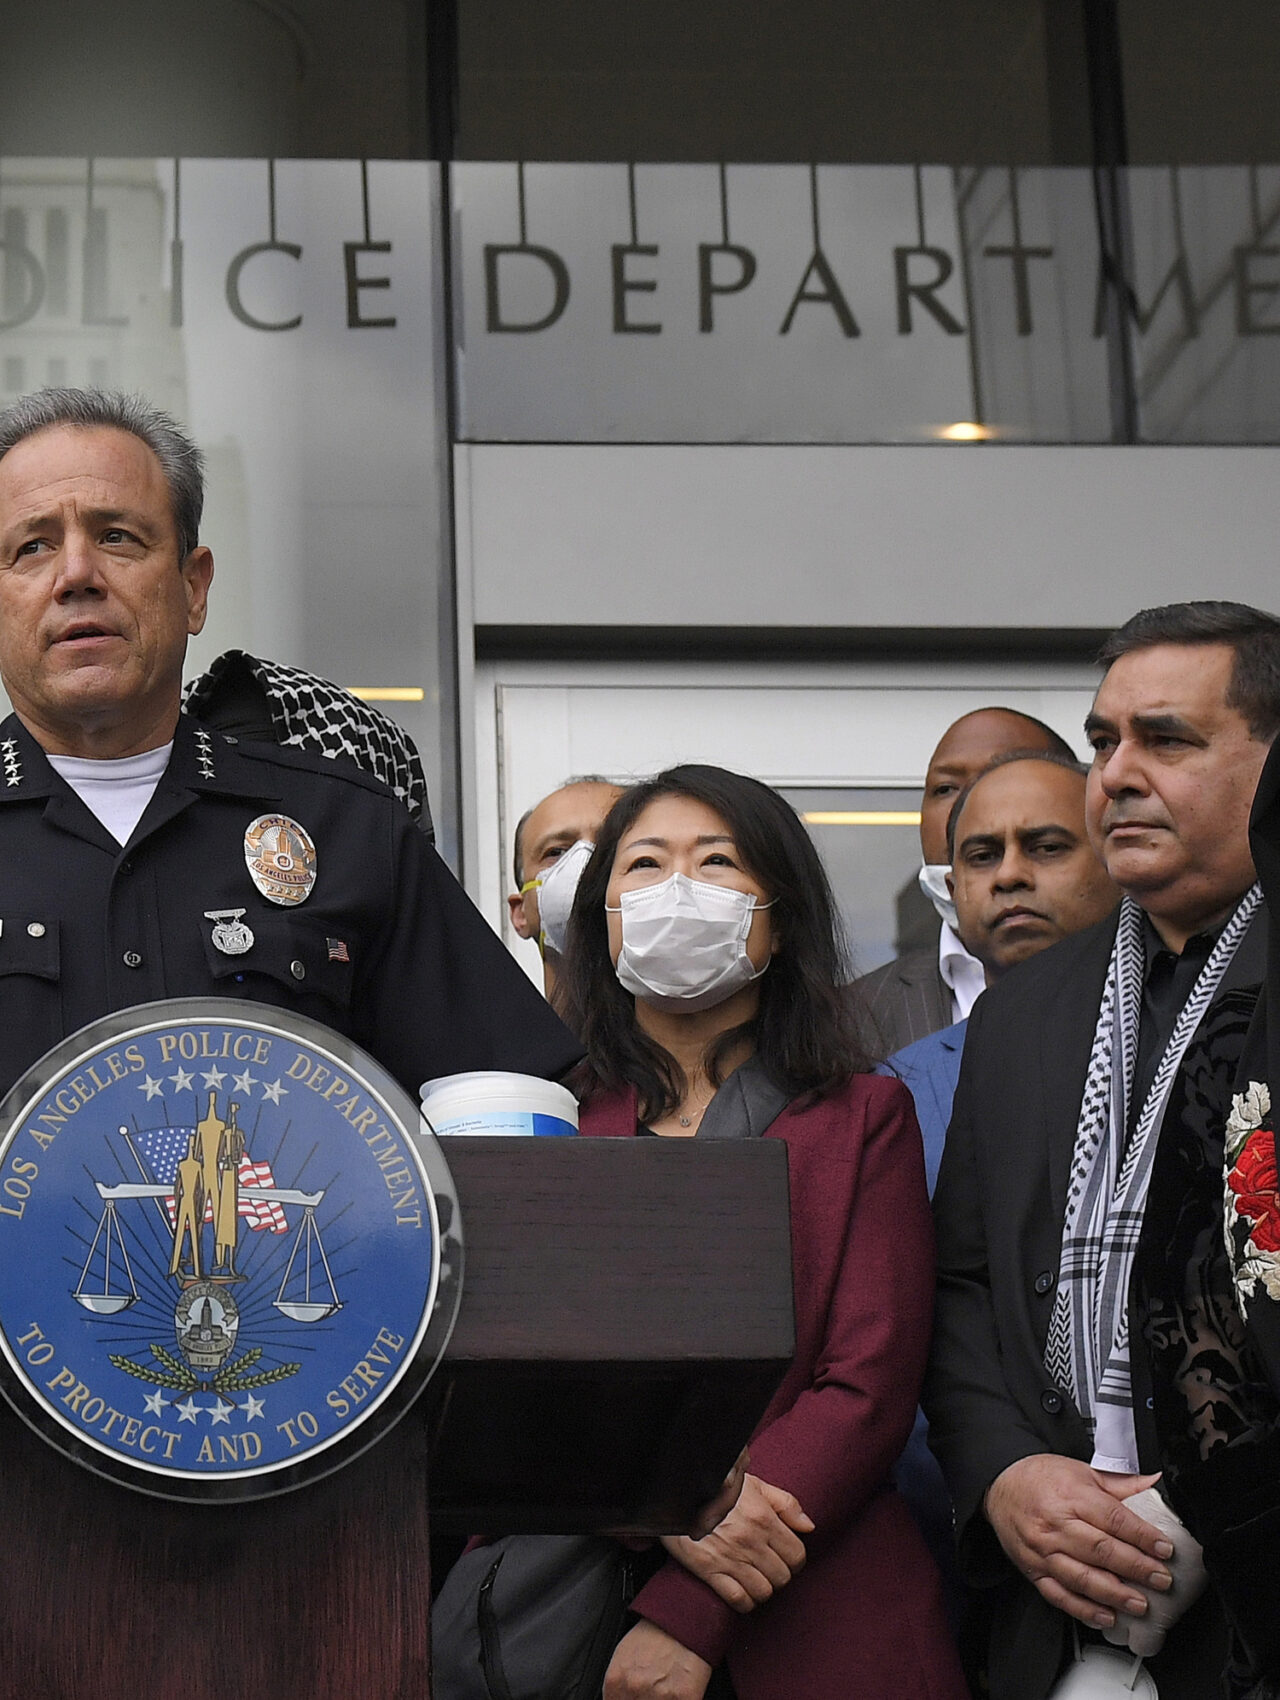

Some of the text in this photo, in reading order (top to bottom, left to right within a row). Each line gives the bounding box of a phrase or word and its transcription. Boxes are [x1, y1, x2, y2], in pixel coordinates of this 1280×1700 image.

[28, 1044, 146, 1152] ANGELES
[158, 1031, 273, 1065] POLICE
[285, 1051, 423, 1229] DEPARTMENT
[16, 1322, 405, 1463] TO PROTECT AND TO SERVE
